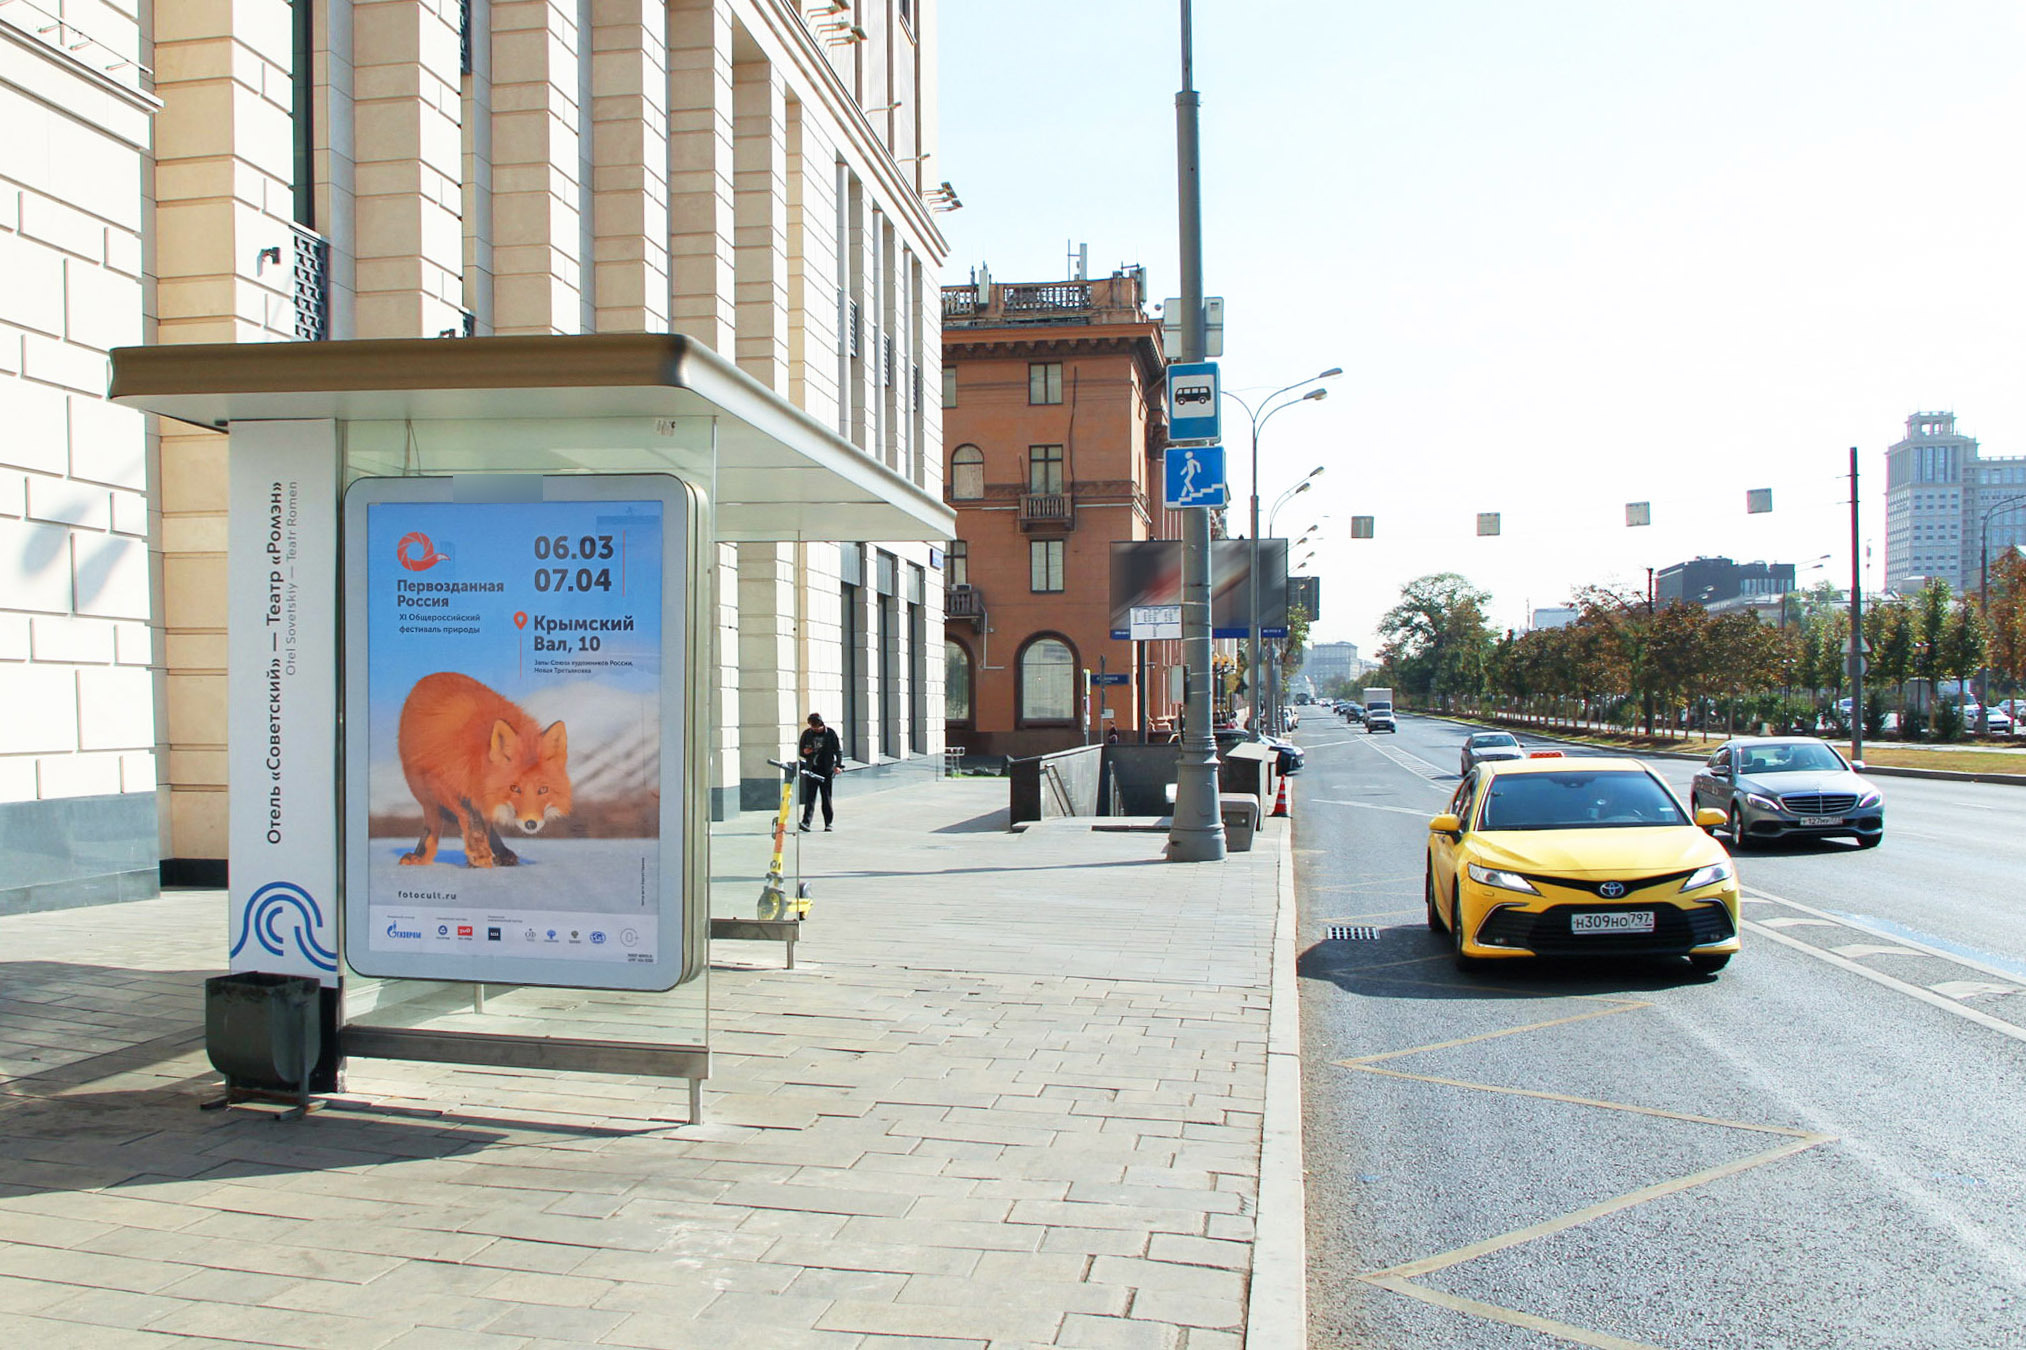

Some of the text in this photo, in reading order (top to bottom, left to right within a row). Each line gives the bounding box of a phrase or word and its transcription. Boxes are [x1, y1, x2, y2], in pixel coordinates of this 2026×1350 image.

[286, 481, 297, 526] Romen
[266, 482, 282, 565] «Ромэн»
[286, 530, 297, 562] Teatr
[534, 536, 614, 560] 06.03
[397, 580, 504, 595] Первозданная
[534, 569, 612, 592] 07.04
[266, 571, 284, 626] Театр
[397, 596, 449, 608] Россия
[286, 583, 298, 644] Sovetskiy
[409, 613, 481, 623] Общероссийский
[534, 614, 634, 635] Крымский
[399, 626, 481, 635] фестиваль природы
[534, 636, 601, 653] Вал, 10
[286, 649, 297, 675] Otel
[266, 658, 281, 780] «Советский»
[266, 786, 281, 844] Отель
[398, 890, 457, 900] fotocult.ru
[1575, 913, 1651, 929] Н309НО 797
